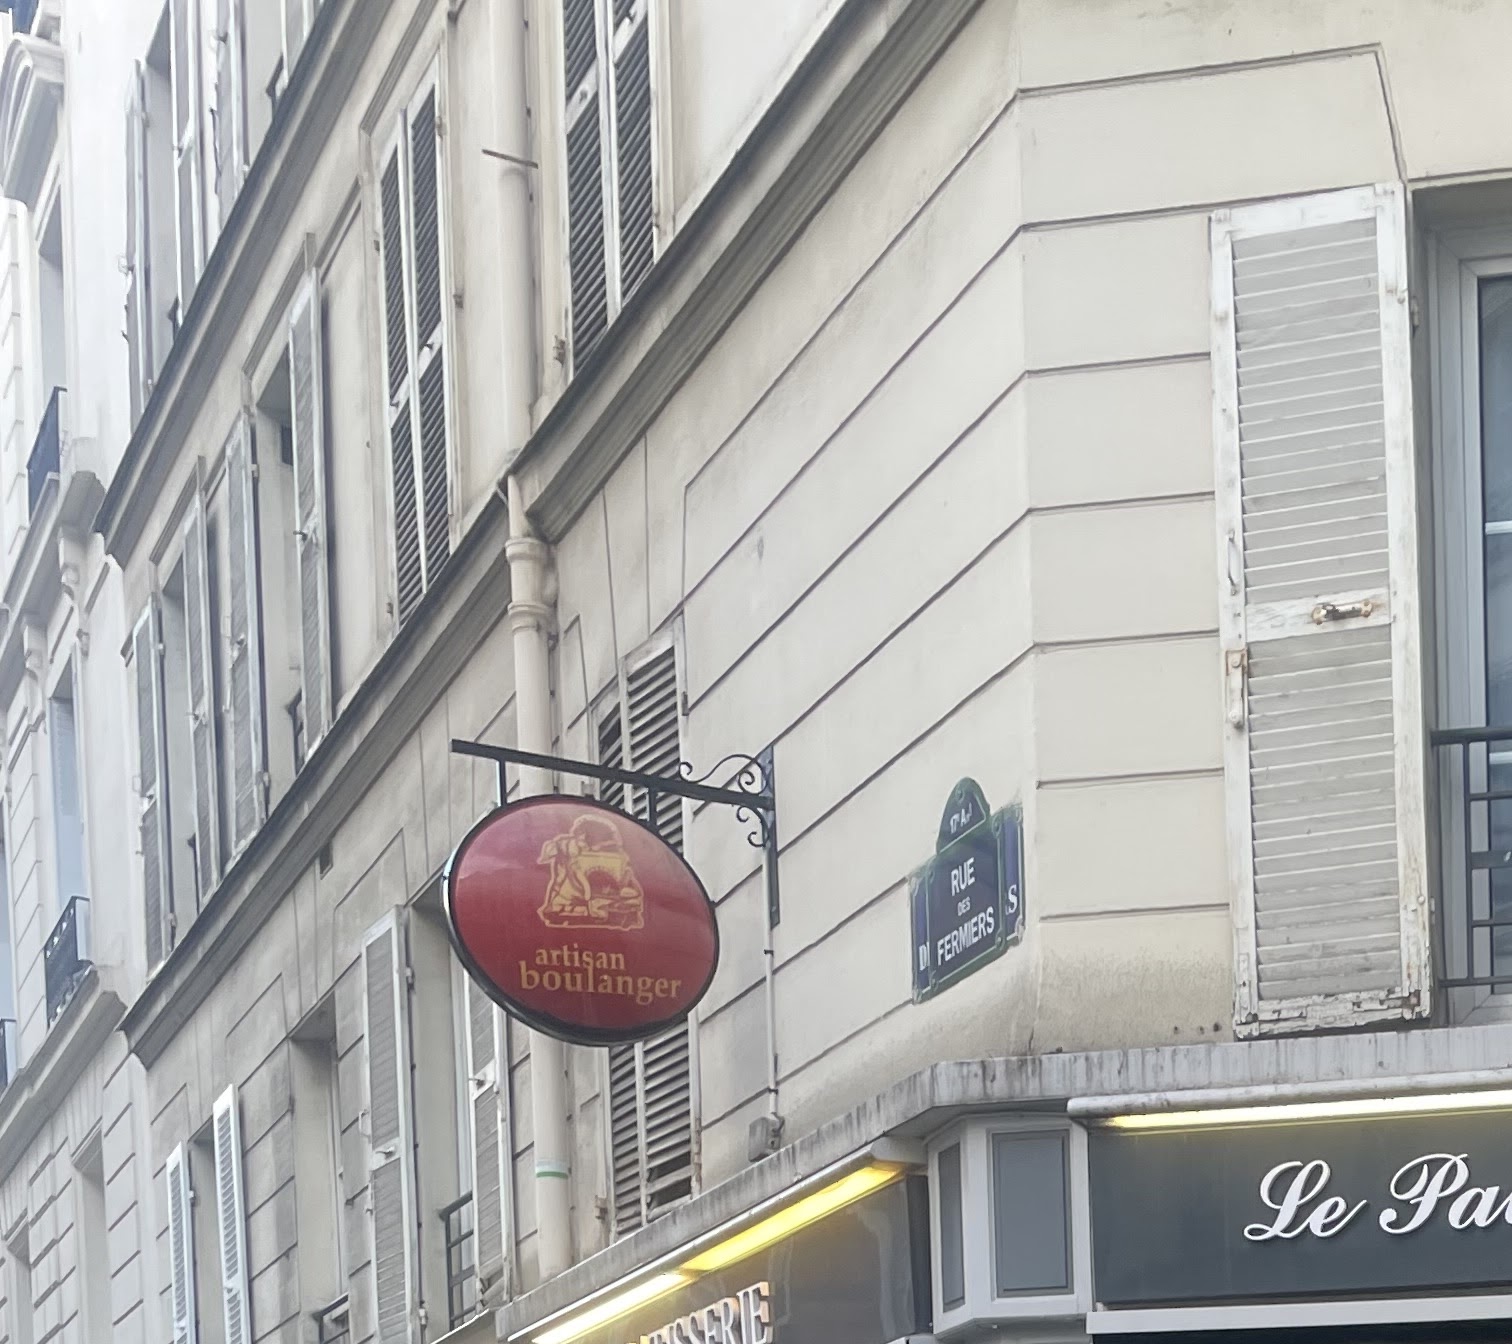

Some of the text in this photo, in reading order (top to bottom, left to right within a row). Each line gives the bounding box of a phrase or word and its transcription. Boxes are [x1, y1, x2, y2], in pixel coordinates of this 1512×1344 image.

[951, 857, 976, 897] RUE
[957, 896, 971, 917] DES
[535, 943, 626, 971] artisan
[937, 906, 995, 967] FERMIERS
[519, 960, 683, 1005] boulanger
[1243, 1159, 1367, 1242] Le
